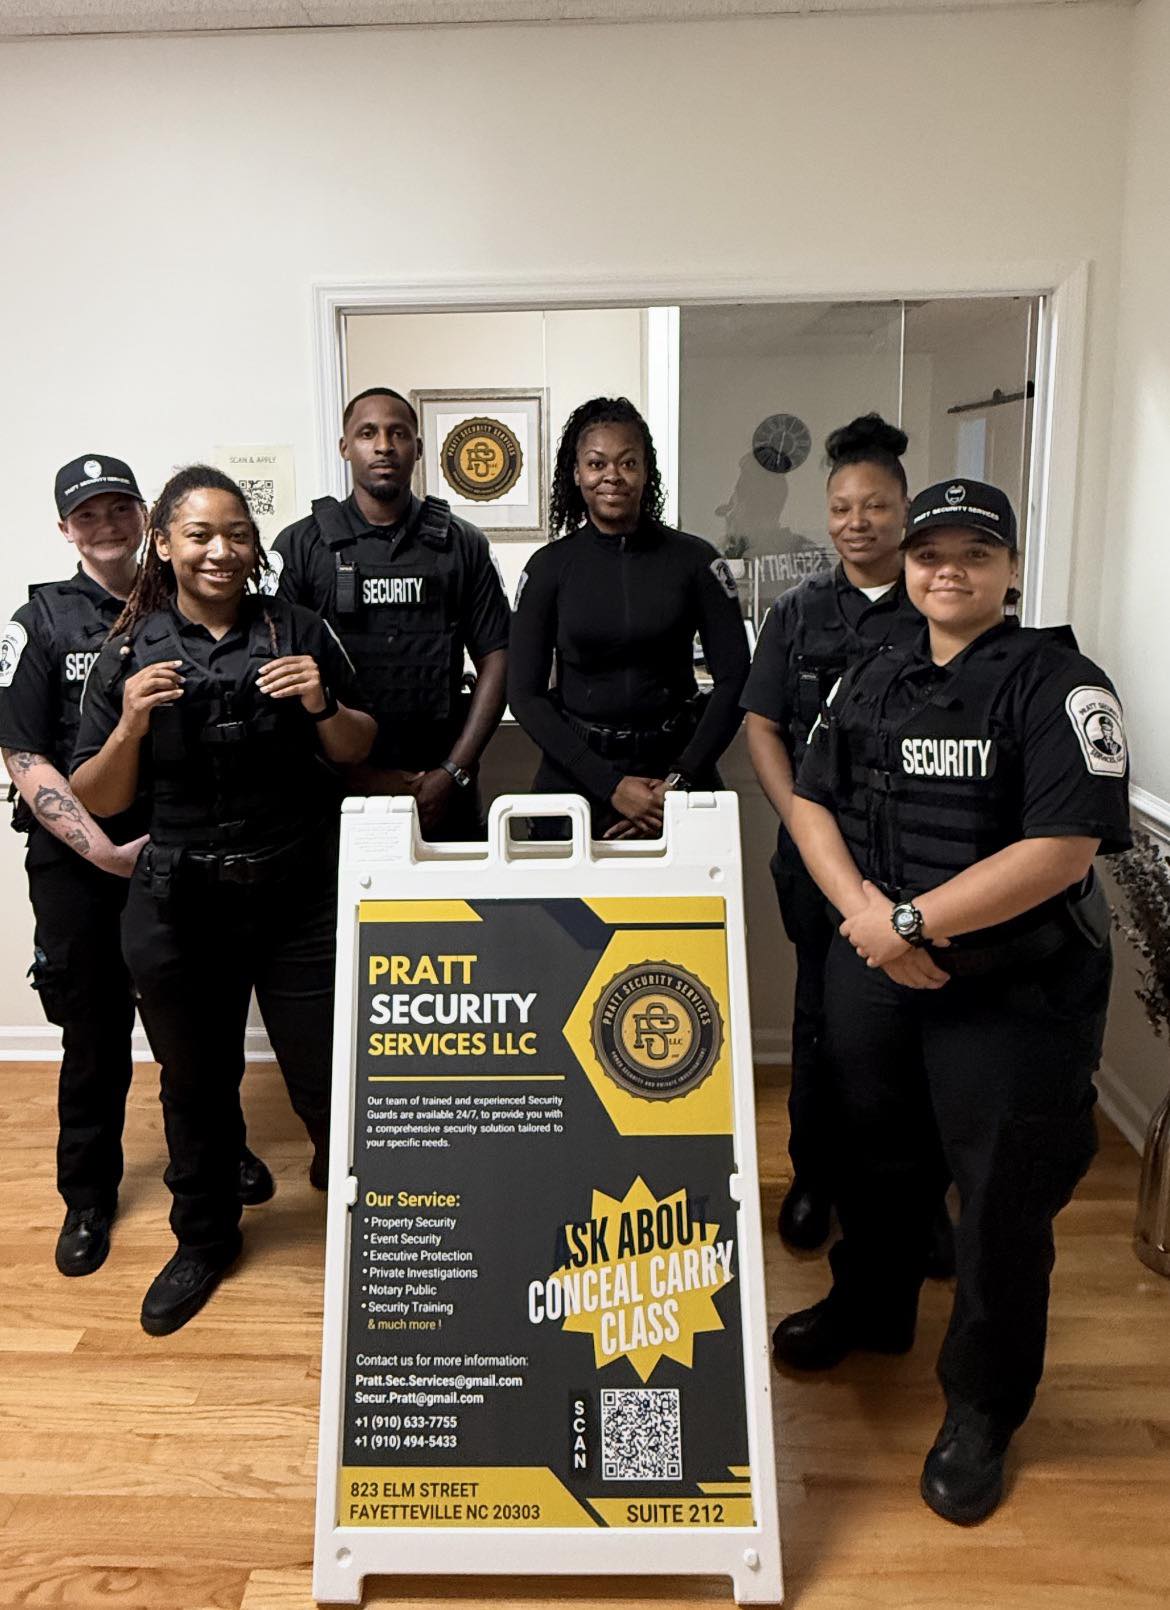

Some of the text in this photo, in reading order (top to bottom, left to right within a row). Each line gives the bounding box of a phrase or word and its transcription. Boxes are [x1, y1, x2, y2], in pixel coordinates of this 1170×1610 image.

[363, 578, 423, 603] SECURITY
[66, 653, 100, 680] SEC
[902, 739, 991, 776] SECURITY
[369, 955, 477, 985] PRATT
[603, 975, 711, 1025] PRATT SECURITY SERVICES
[369, 993, 537, 1024] SECURITY
[368, 1032, 537, 1056] SERVICES LLC
[368, 1096, 563, 1107] Our team of trained and experienced Security
[367, 1110, 397, 1119] Guards
[416, 1110, 454, 1119] available
[456, 1110, 479, 1120] 24/7,
[481, 1111, 489, 1119] to
[492, 1110, 524, 1120] provide
[526, 1111, 542, 1121] you
[545, 1110, 563, 1119] with
[367, 1123, 563, 1136] a comprehensive security solution tailored to
[366, 1137, 450, 1149] your specific needs.
[366, 1191, 460, 1207] Our Service:
[371, 1216, 456, 1230] Property Security
[371, 1233, 441, 1246] Event Security
[556, 1197, 708, 1271] ASK ABOUT
[370, 1250, 472, 1261] Executive Protection
[370, 1267, 478, 1280] Private Investigations
[529, 1240, 733, 1324] CONCEAL CARRY
[369, 1284, 437, 1297] Notary Public
[368, 1302, 453, 1315] Security Training
[368, 1319, 375, 1329] &
[378, 1318, 406, 1329] much
[409, 1321, 436, 1329] more
[601, 1299, 679, 1355] CLASS
[356, 1354, 528, 1366] Contact us for more information:
[355, 1374, 523, 1389] Pratt.Sec.Services@gmail.com
[355, 1392, 484, 1407] Secur.Pratt@gmail.com
[355, 1415, 457, 1430] +1 (910) 633-7755
[574, 1401, 586, 1468] SCAN
[355, 1435, 457, 1450] +1 (910) 494-5433
[351, 1482, 479, 1497] 823 ELM STREET
[350, 1504, 540, 1520] FAYETTEVILLE NC 20303
[627, 1504, 724, 1523] SUITE 212
